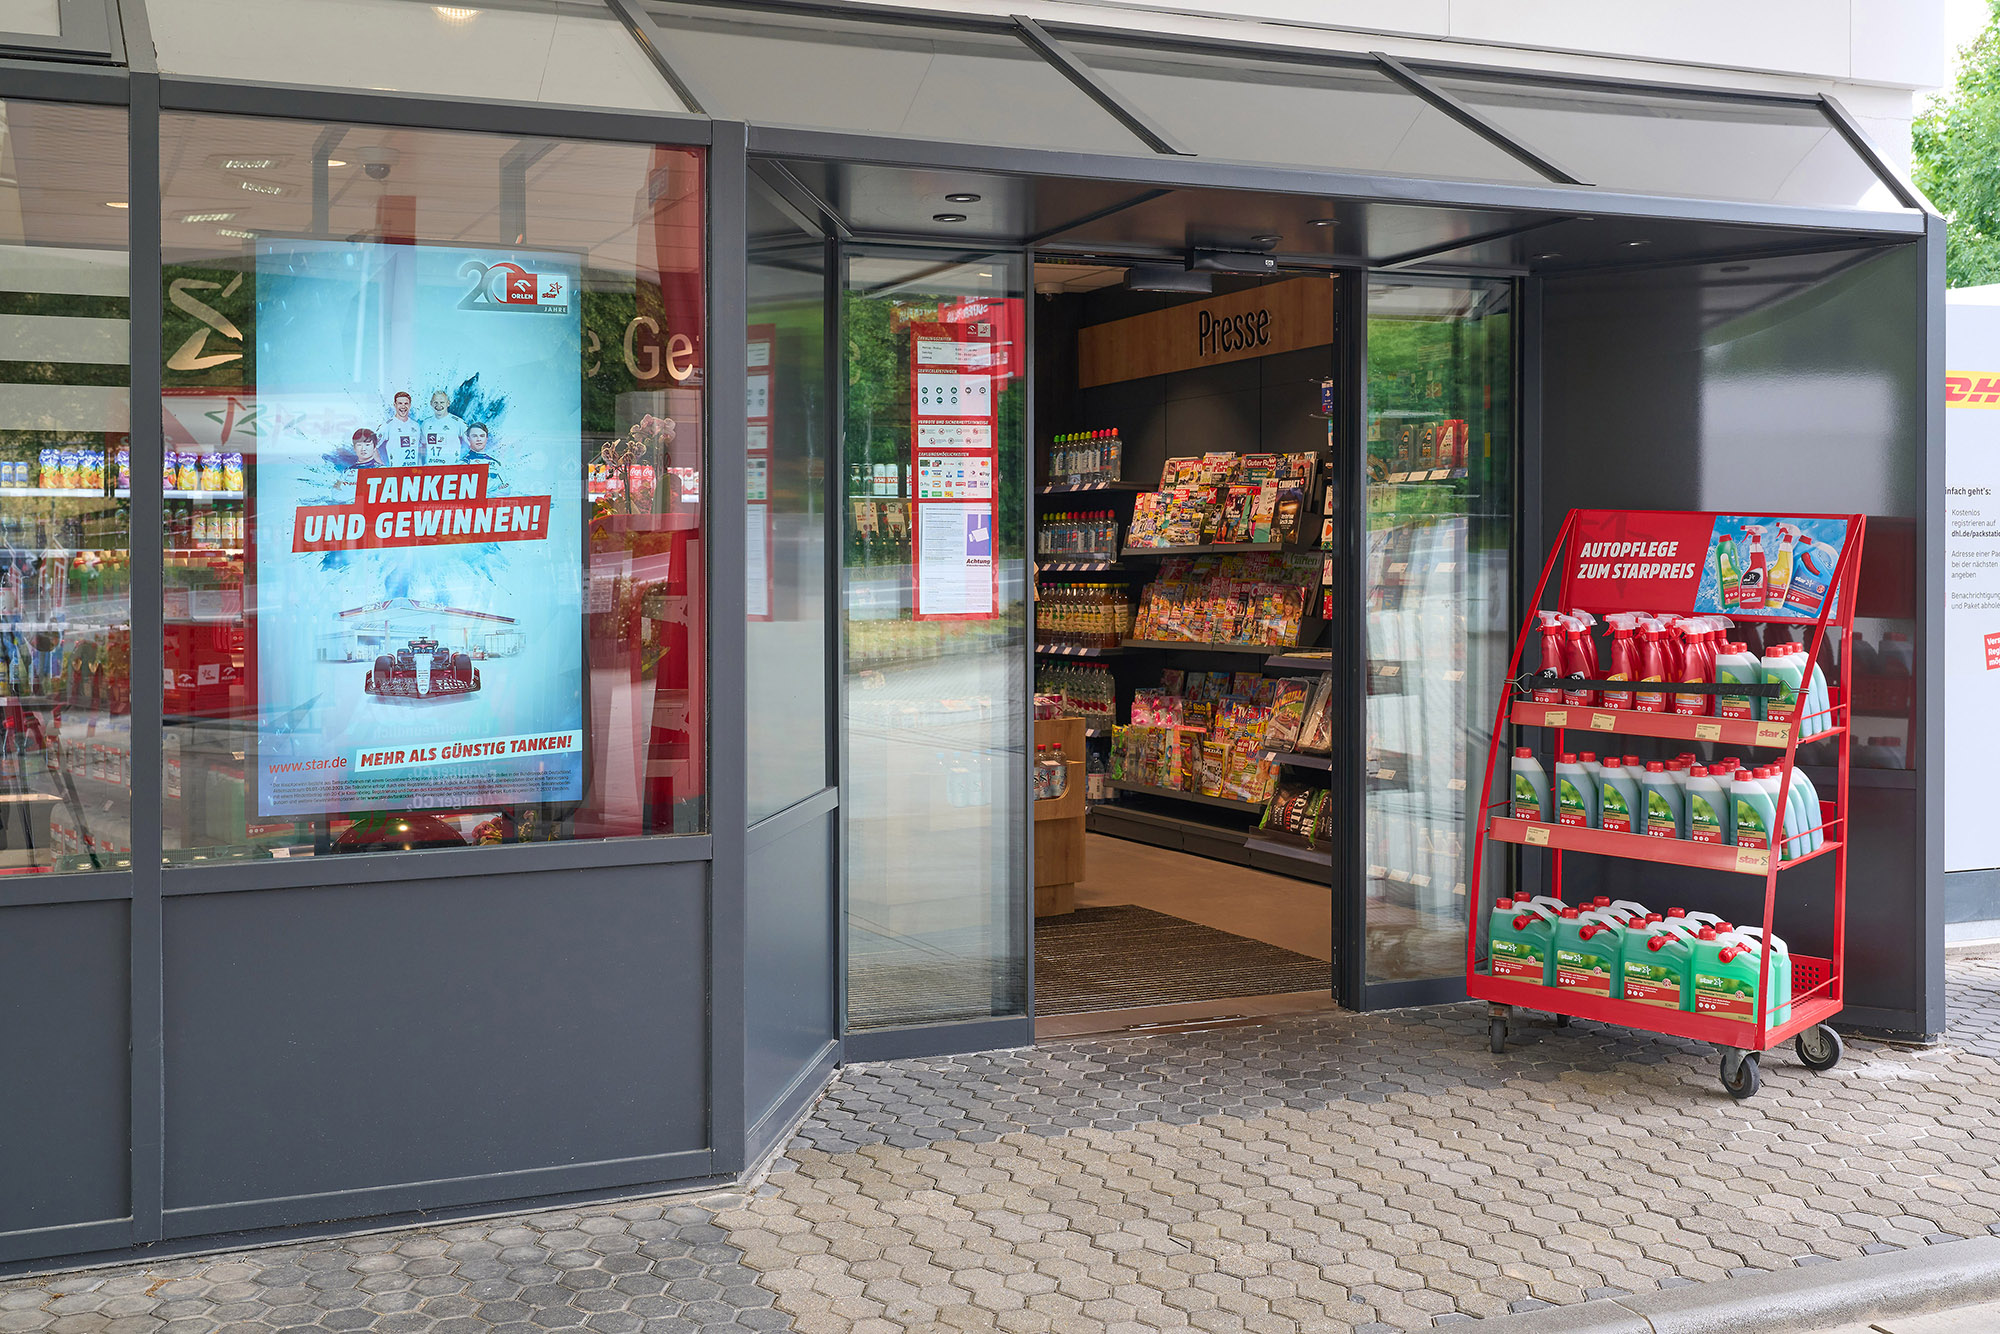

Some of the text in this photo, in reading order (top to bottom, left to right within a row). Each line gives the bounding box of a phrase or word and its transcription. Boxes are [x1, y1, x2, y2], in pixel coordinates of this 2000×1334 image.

[541, 291, 559, 300] star
[1199, 308, 1272, 357] Presse
[404, 448, 416, 460] 23
[430, 446, 443, 456] 17
[366, 473, 479, 504] TANKEN
[1278, 480, 1300, 489] COMPACT
[1945, 487, 1992, 497] infach geht's:
[303, 504, 541, 542] UND GEWINNEN!
[1951, 519, 1986, 528] registrieren
[1580, 541, 1679, 558] AUTOPFLEGE
[1972, 560, 1999, 568] nächsten
[1577, 563, 1696, 580] ZUM STARPREIS
[1951, 571, 1977, 580] angeben
[1758, 729, 1779, 738] star
[360, 734, 573, 768] MEHR ALS GÜNSTIG TANKEN!
[1248, 740, 1259, 752] TV
[268, 756, 348, 775] www.star.de
[1738, 856, 1760, 865] star
[1699, 977, 1713, 985] star
